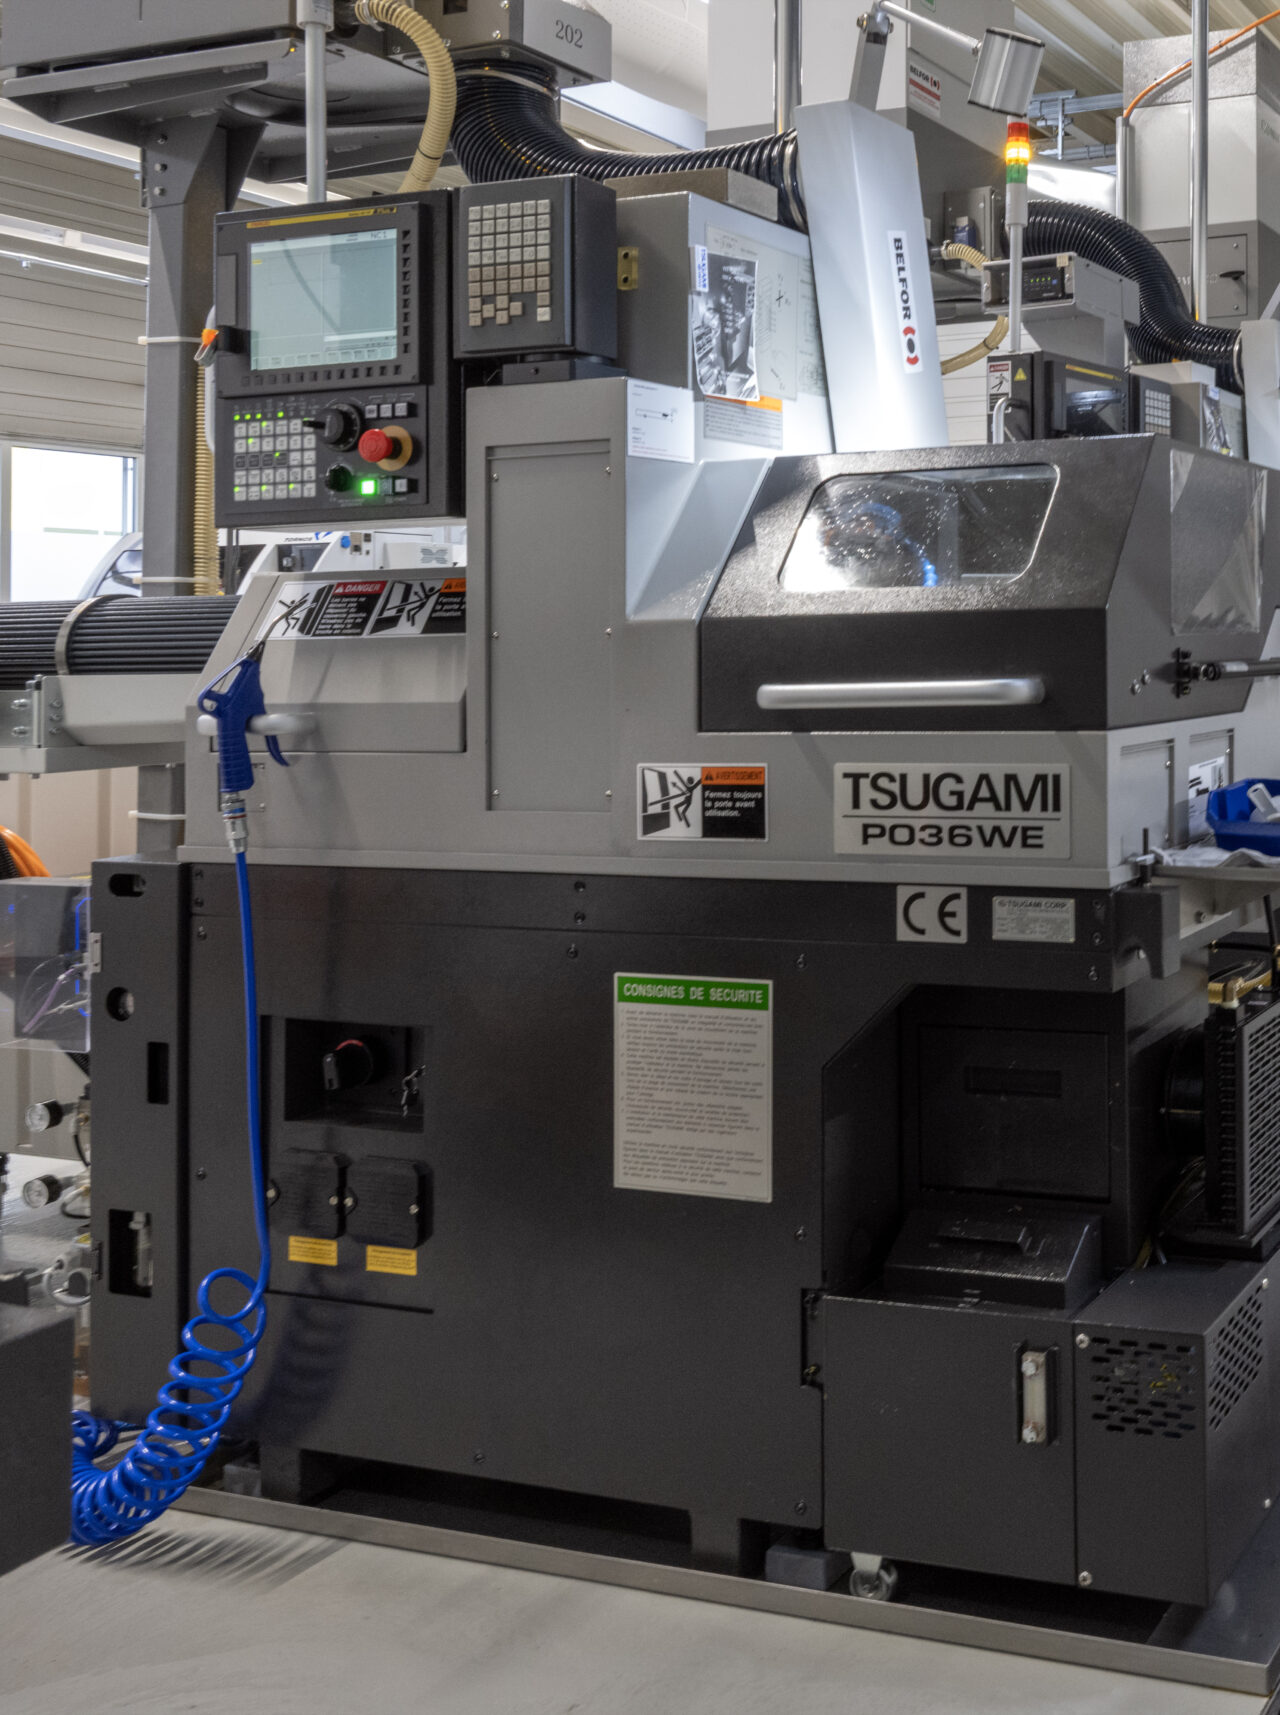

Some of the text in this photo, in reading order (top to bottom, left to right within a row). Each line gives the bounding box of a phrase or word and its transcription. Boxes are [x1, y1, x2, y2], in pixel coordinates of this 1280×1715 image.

[555, 19, 584, 49] 202
[909, 64, 930, 83] BELFOR
[893, 237, 912, 321] BELFOR
[343, 583, 381, 593] DANGER
[704, 791, 763, 800] Fermez toujours
[842, 772, 1062, 813] TSUGAMI
[704, 800, 712, 808] la
[714, 800, 733, 809] porte
[902, 891, 962, 937] CE
[623, 983, 764, 1004] CONSIGNES DE SECURITE
